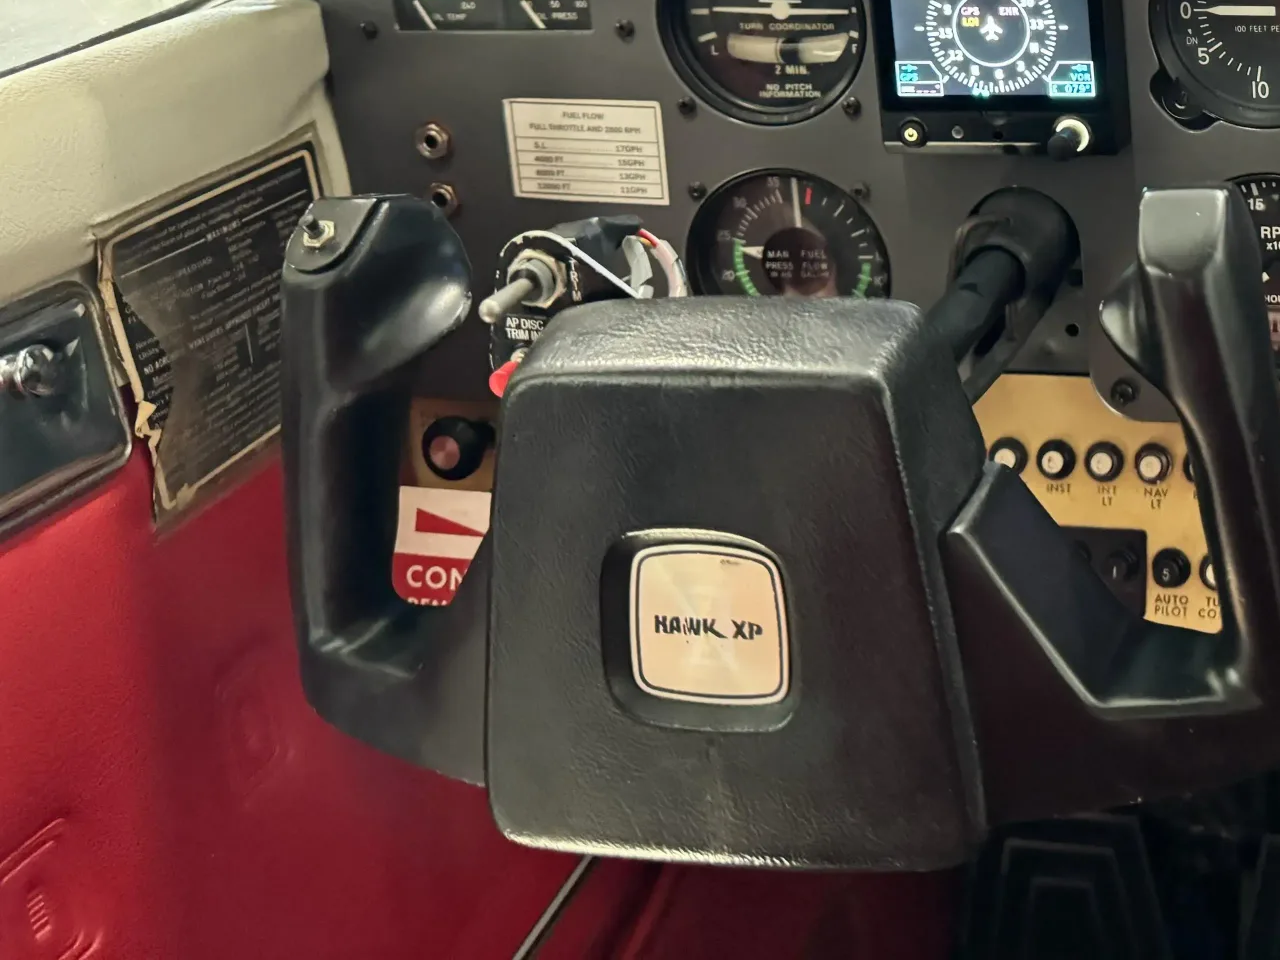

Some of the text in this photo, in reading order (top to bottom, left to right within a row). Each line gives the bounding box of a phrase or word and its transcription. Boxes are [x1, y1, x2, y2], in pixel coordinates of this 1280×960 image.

[506, 317, 544, 330] AP DISC
[1046, 483, 1071, 493] INST
[1154, 594, 1188, 605] AUTO
[1154, 605, 1187, 616] PILOT
[654, 615, 763, 640] HAWK XP
